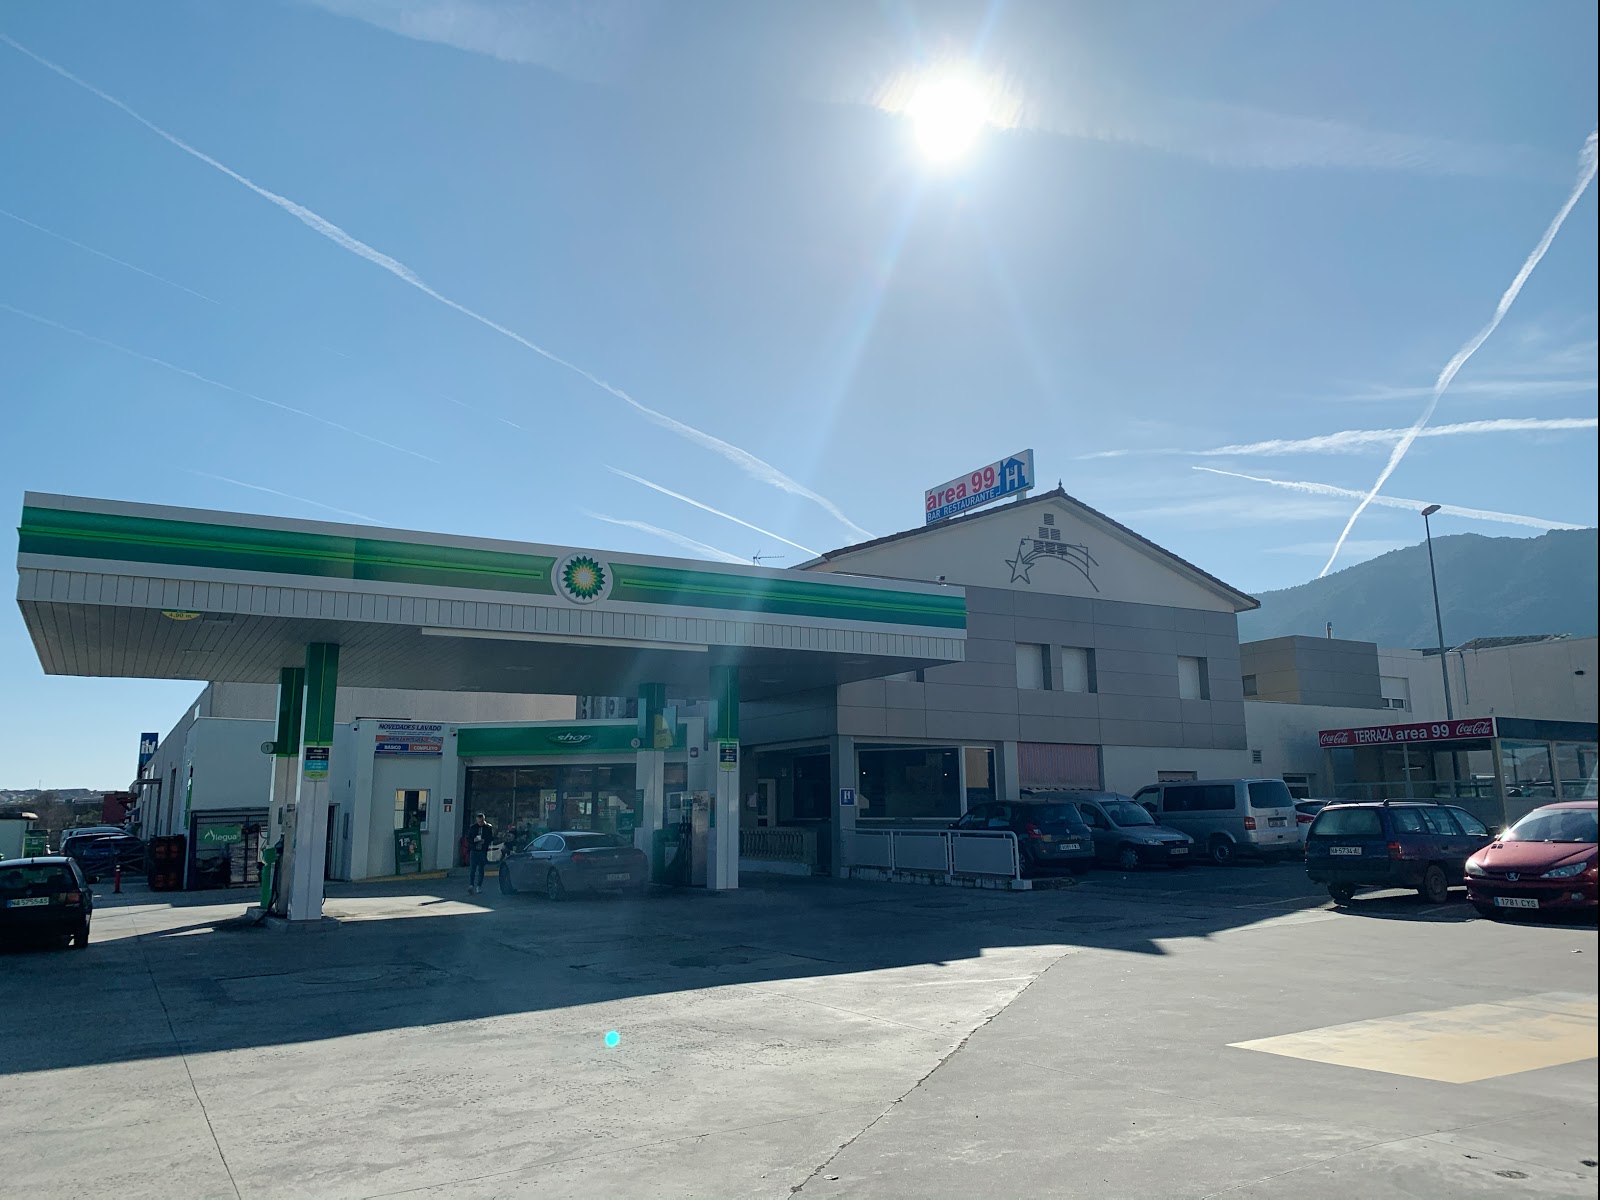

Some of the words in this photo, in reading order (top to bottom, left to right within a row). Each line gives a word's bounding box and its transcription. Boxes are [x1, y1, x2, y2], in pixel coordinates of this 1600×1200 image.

[927, 483, 966, 511] área
[972, 467, 995, 493] 99
[927, 510, 941, 522] BAR
[944, 488, 995, 515] RESTAURANTE
[378, 723, 416, 731] NOVEDADES
[416, 724, 442, 732] LAVADO
[1353, 728, 1394, 743] TERRAZA
[1395, 727, 1428, 741] area
[1431, 724, 1450, 738] 99
[557, 732, 591, 743] shop
[1501, 898, 1519, 906] 1781
[1520, 899, 1537, 908] CYS
